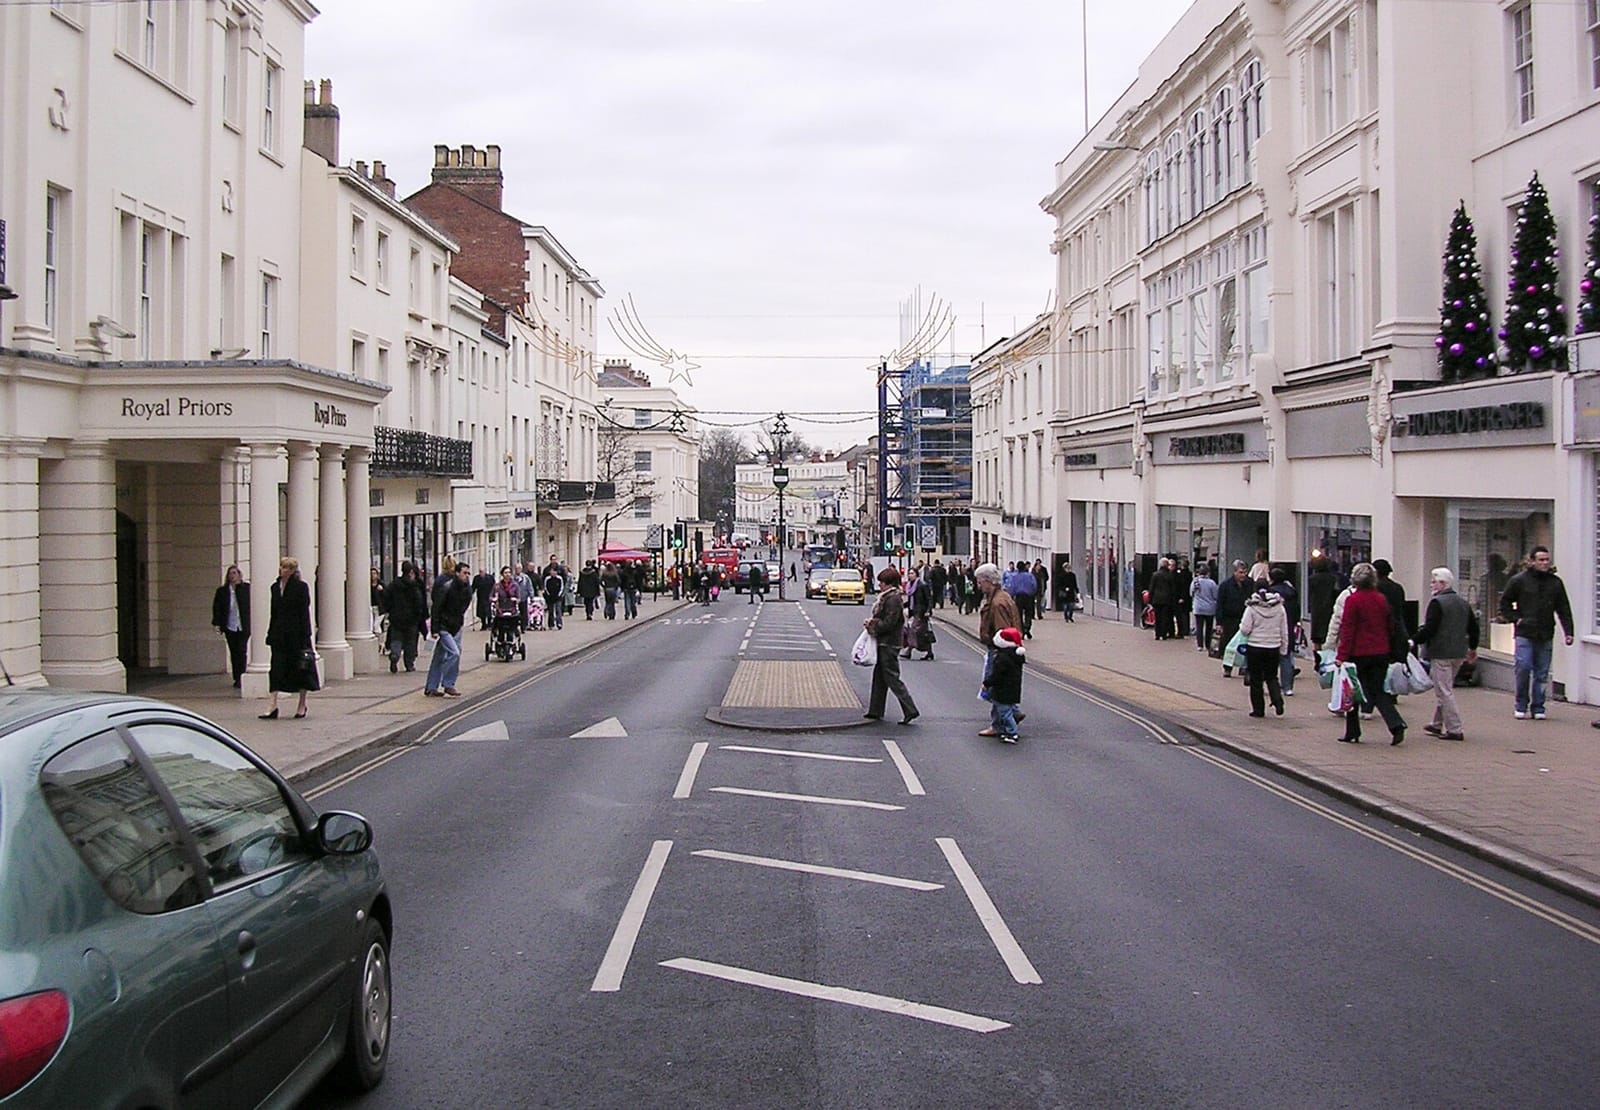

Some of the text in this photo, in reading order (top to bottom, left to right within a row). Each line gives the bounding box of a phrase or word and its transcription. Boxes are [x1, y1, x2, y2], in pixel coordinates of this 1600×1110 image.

[121, 397, 233, 421] Royal Priors
[314, 401, 330, 429] Royal
[1408, 401, 1544, 436] HOUSE OF FRASER
